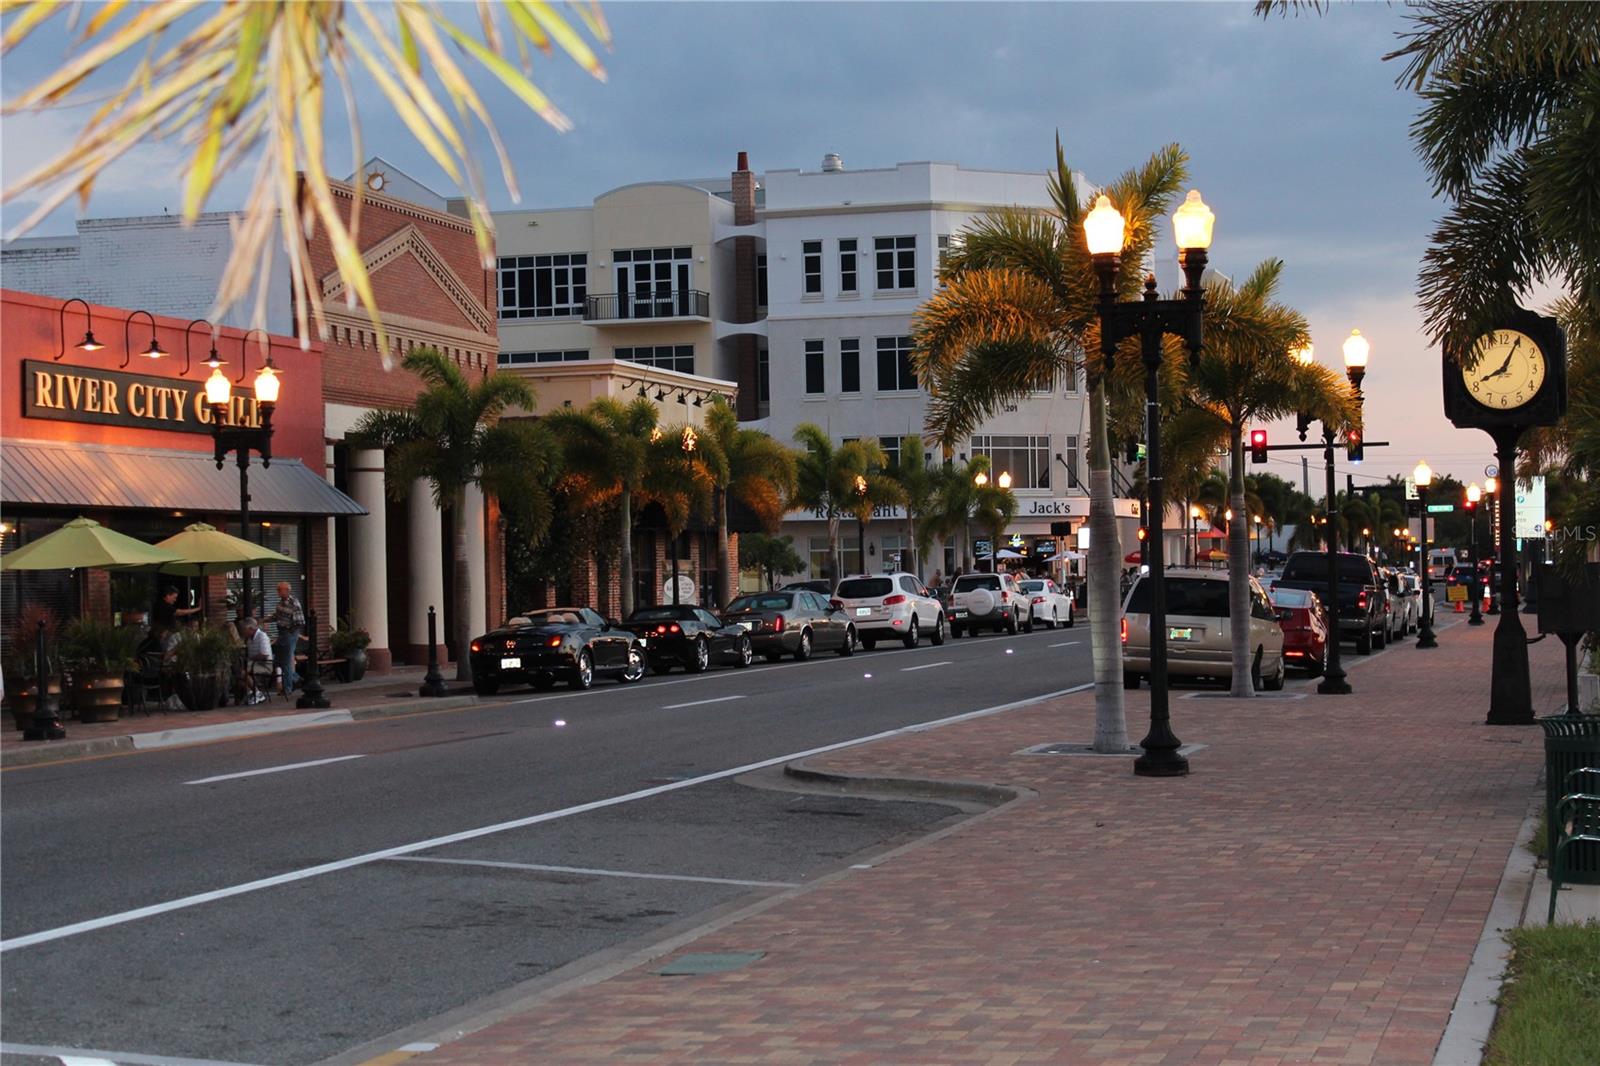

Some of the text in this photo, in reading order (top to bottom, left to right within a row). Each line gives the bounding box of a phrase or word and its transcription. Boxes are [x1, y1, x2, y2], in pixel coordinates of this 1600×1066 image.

[1500, 334, 1509, 345] 12
[1529, 347, 1536, 359] 2
[1532, 364, 1538, 375] 3
[1472, 381, 1480, 393] 8
[1528, 379, 1535, 391] 4
[34, 370, 264, 428] RIVER CITY GILL
[1486, 392, 1493, 404] 7
[1501, 395, 1508, 407] 6
[1516, 391, 1523, 403] 5
[1029, 501, 1071, 514] Jack's
